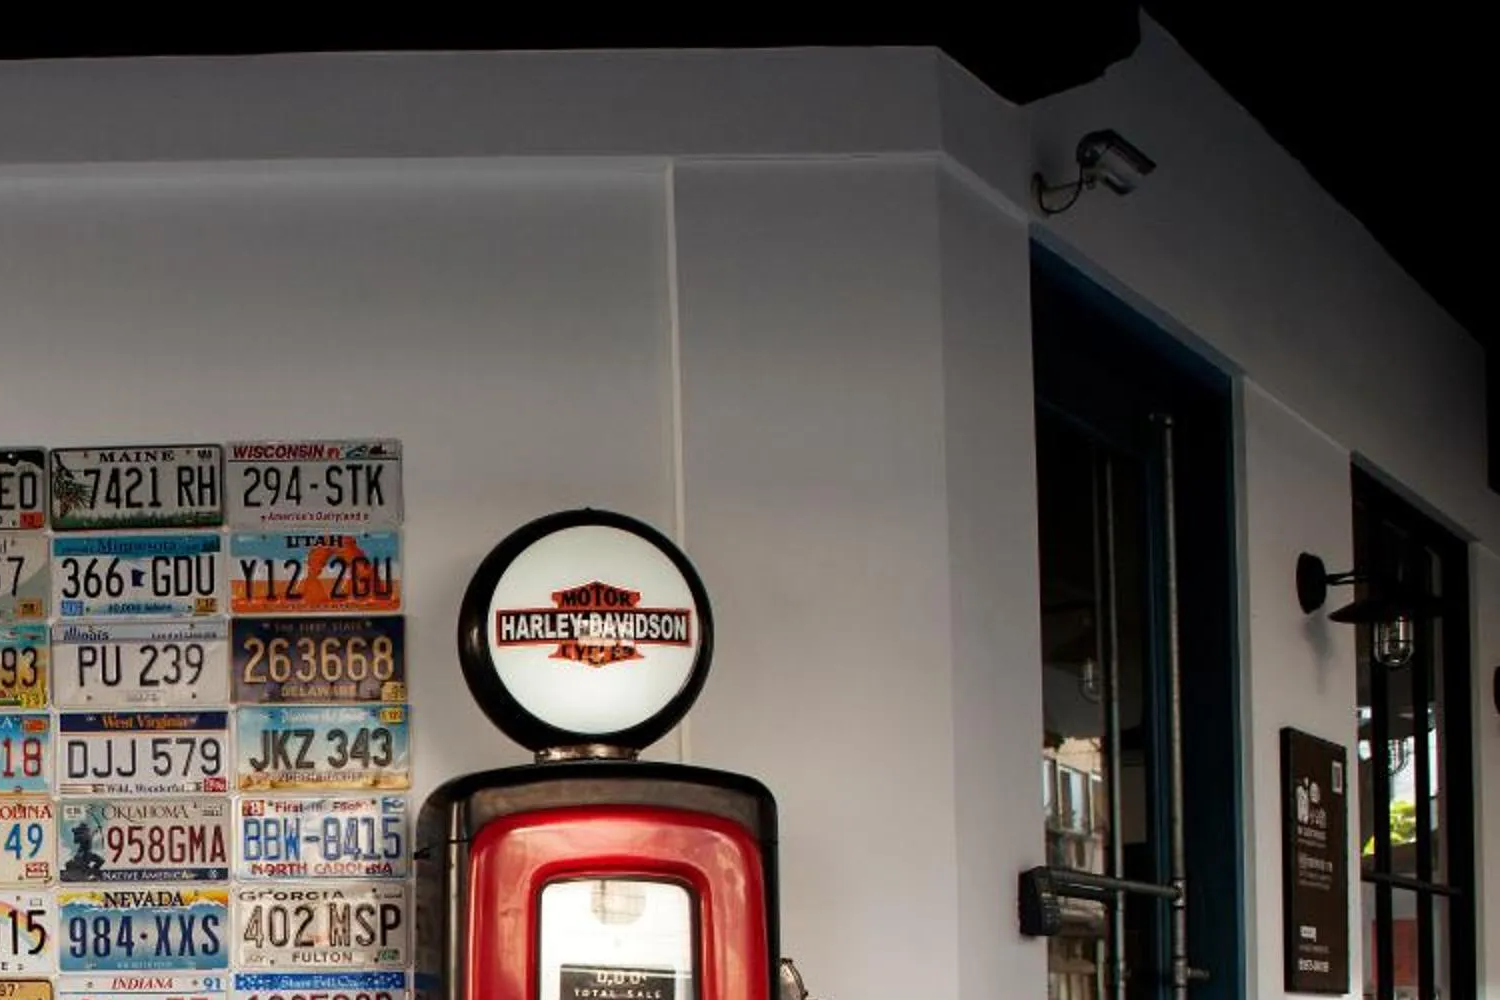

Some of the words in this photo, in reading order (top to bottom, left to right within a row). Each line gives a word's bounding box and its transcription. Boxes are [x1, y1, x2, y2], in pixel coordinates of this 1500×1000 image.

[100, 452, 175, 463] MAINE
[233, 445, 325, 459] WISCONSIN
[84, 466, 161, 509] 7421
[178, 465, 216, 505] RH
[244, 465, 384, 507] 294-STK
[284, 535, 343, 549] UTAH
[63, 558, 124, 598] 366
[152, 556, 215, 597] GDU
[240, 559, 302, 600] Y12
[563, 587, 632, 607] MOTOR
[78, 645, 121, 687] PU
[139, 643, 204, 687] 239
[243, 635, 394, 683] 263668
[102, 713, 132, 729] West
[67, 740, 136, 778] DJJ
[152, 738, 222, 777] 579
[250, 729, 315, 771] JKZ
[327, 727, 393, 768] 343
[101, 805, 189, 821] OKLAHOMA
[106, 825, 227, 864] 958GMA
[251, 864, 307, 876] NORTH
[103, 891, 184, 909] NEVADA
[239, 890, 344, 901] GEORGIA
[244, 905, 315, 948] 402
[292, 952, 353, 963] FULTON
[112, 978, 173, 989] INDIANA
[203, 977, 221, 989] 91
[574, 988, 615, 998] TOTAL
[627, 989, 662, 998] SALE
